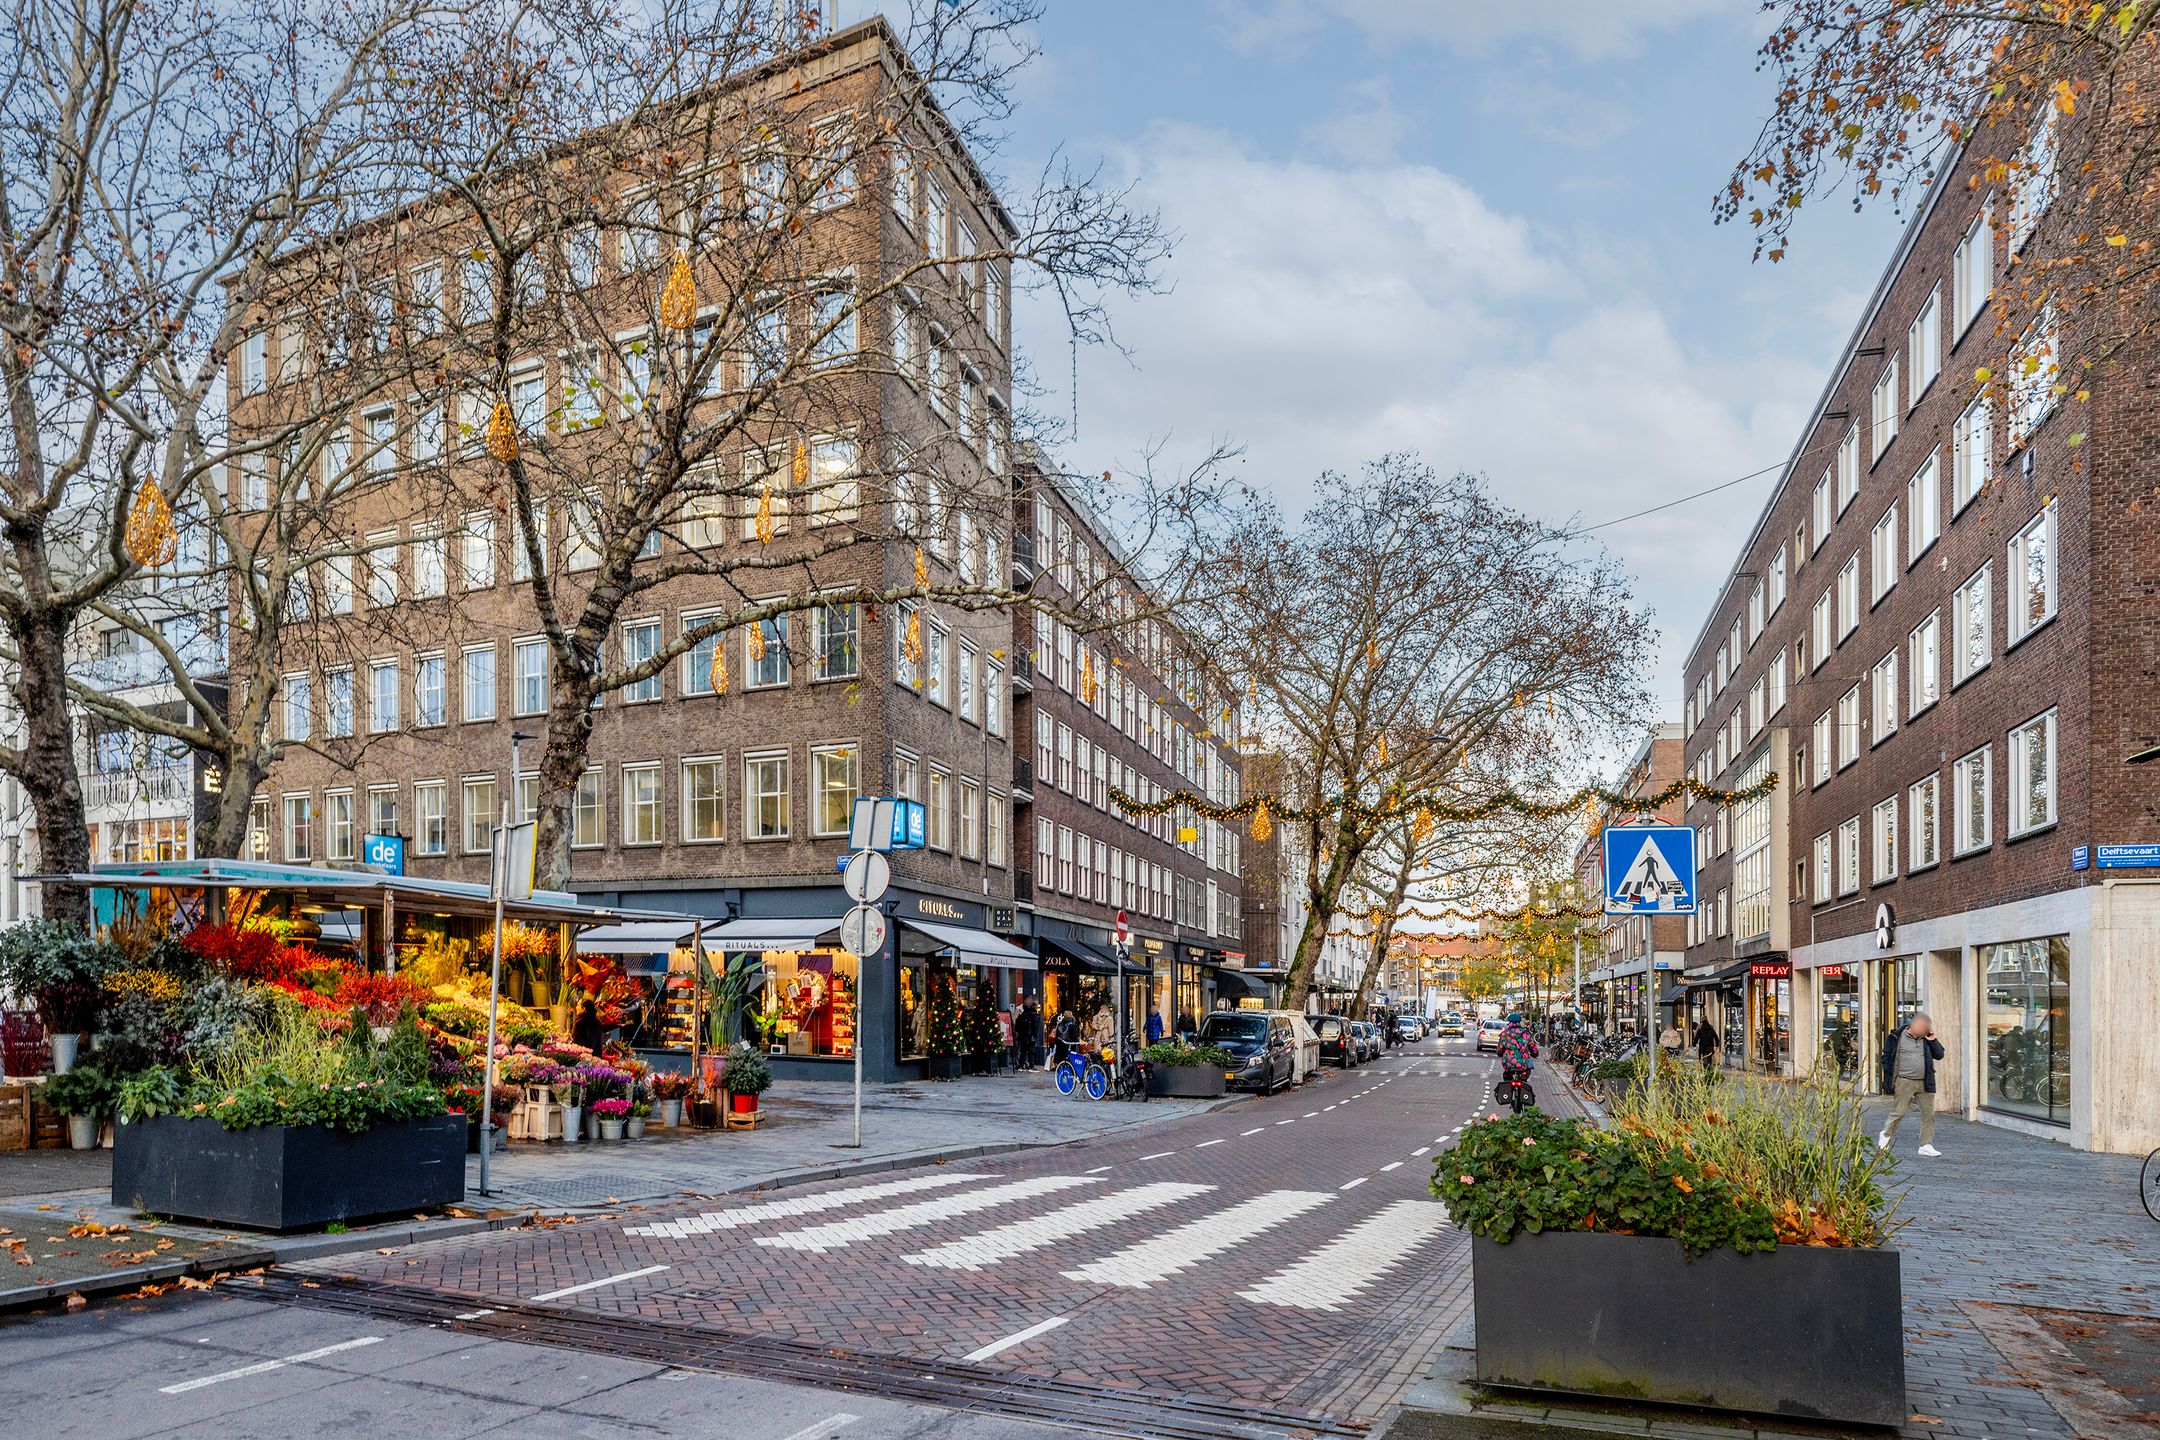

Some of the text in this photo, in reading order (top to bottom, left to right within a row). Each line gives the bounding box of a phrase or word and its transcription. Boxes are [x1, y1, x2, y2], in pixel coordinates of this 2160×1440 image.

[372, 841, 395, 863] de
[2102, 847, 2159, 855] Delftsevaart
[1045, 956, 1071, 966] ZOLA
[1752, 966, 1789, 975] REPLAY
